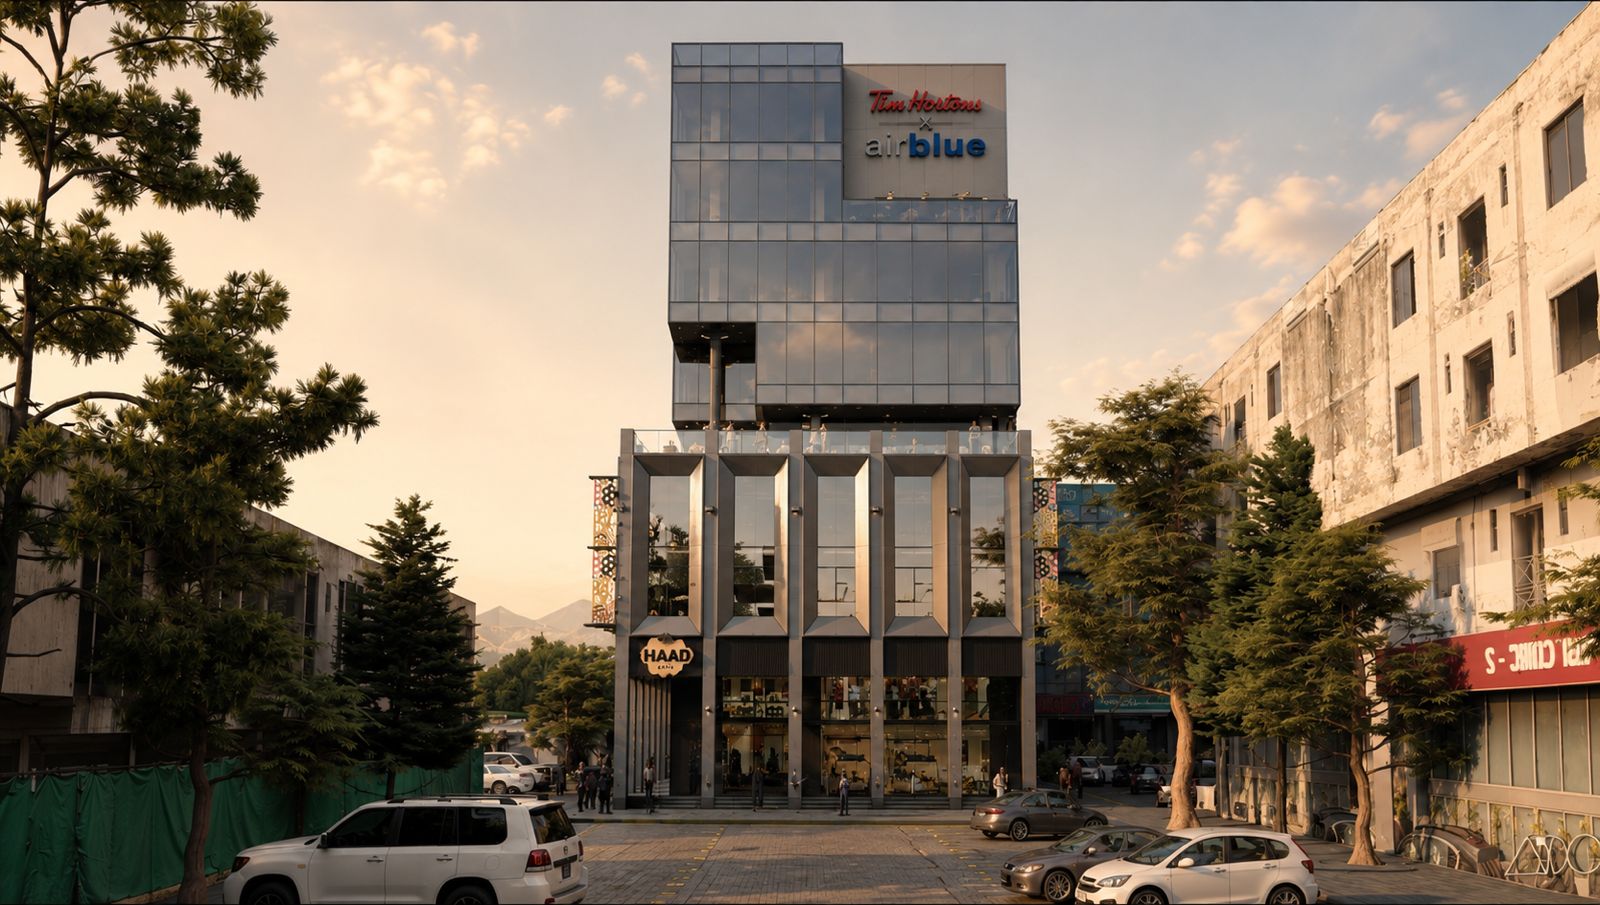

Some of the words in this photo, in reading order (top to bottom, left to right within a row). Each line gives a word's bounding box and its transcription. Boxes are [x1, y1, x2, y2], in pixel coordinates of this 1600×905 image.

[869, 89, 906, 113] Tim
[908, 89, 983, 113] Hortons
[865, 132, 987, 158] airblue
[644, 648, 691, 662] HAAD
